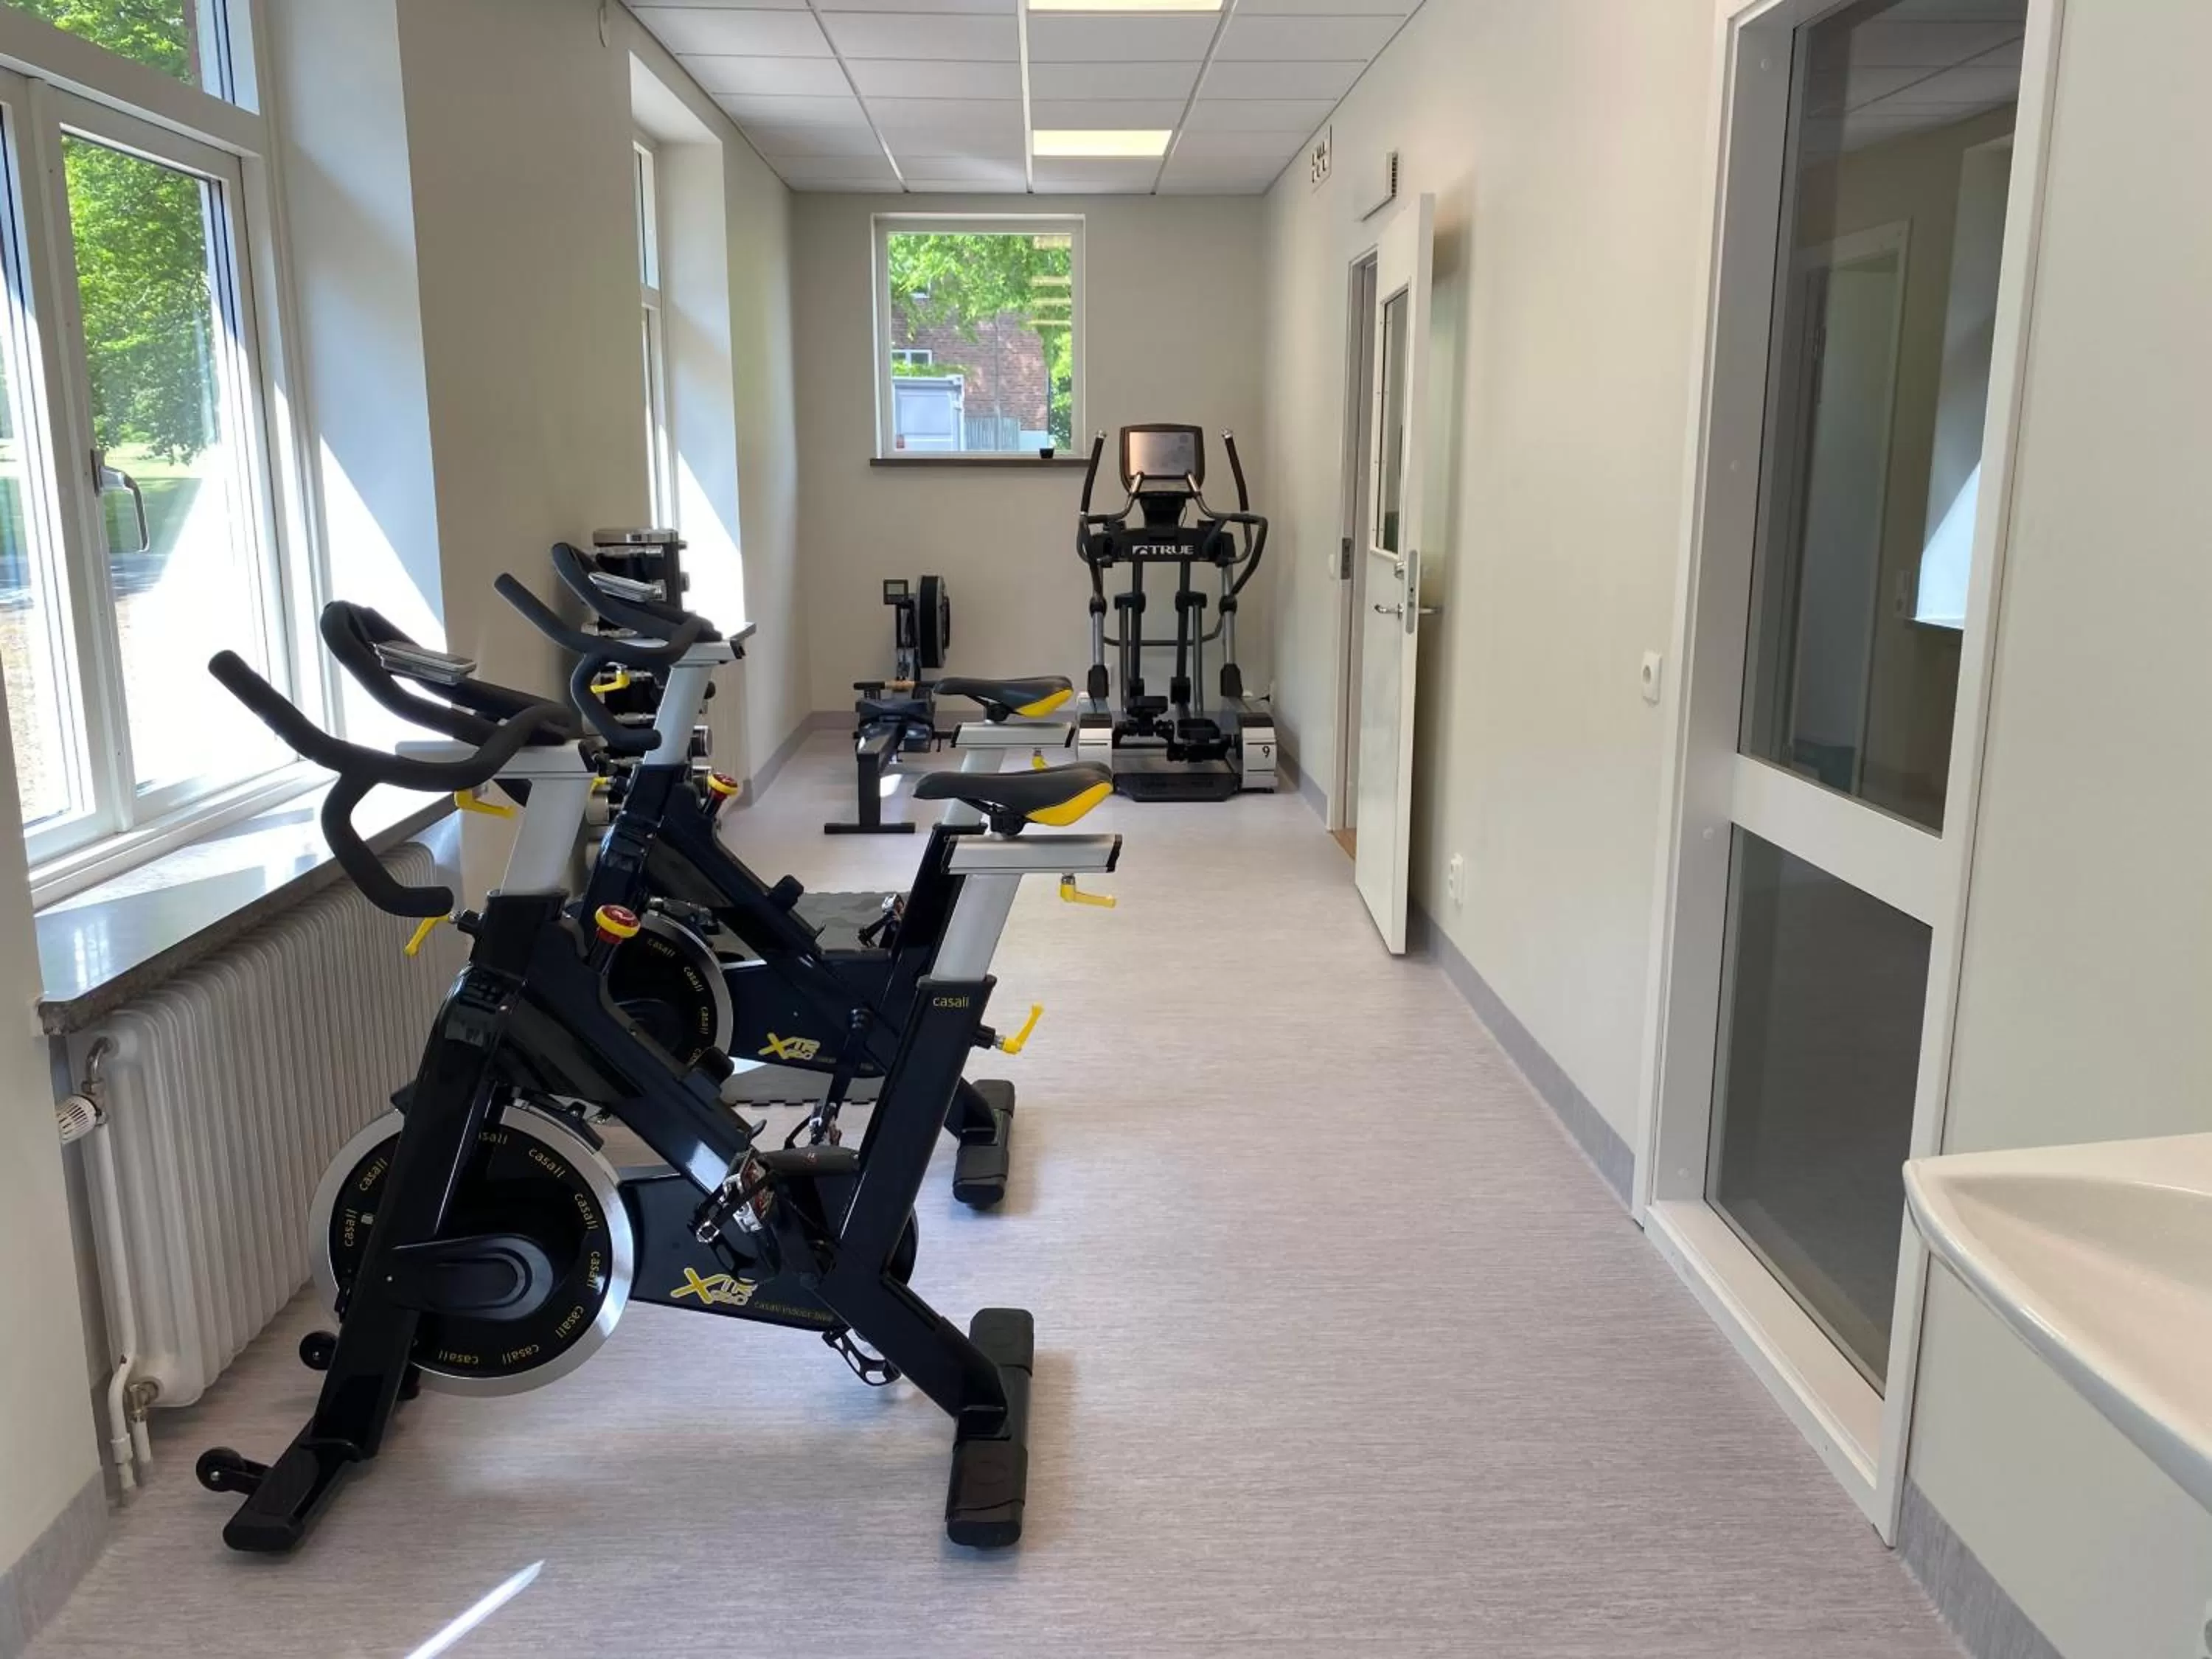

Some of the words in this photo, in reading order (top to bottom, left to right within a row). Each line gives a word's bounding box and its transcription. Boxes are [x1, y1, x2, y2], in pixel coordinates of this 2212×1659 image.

[1148, 545, 1194, 555] TRUE
[1262, 745, 1271, 759] 9
[933, 996, 970, 1009] casall
[479, 1132, 508, 1144] sall
[359, 1157, 389, 1191] casall
[528, 1147, 566, 1178] casall
[574, 1192, 599, 1230] casall
[344, 1208, 358, 1248] casall
[587, 1251, 602, 1290] casall
[555, 1305, 585, 1339] casall
[438, 1349, 479, 1365] casall
[502, 1344, 540, 1365] casall
